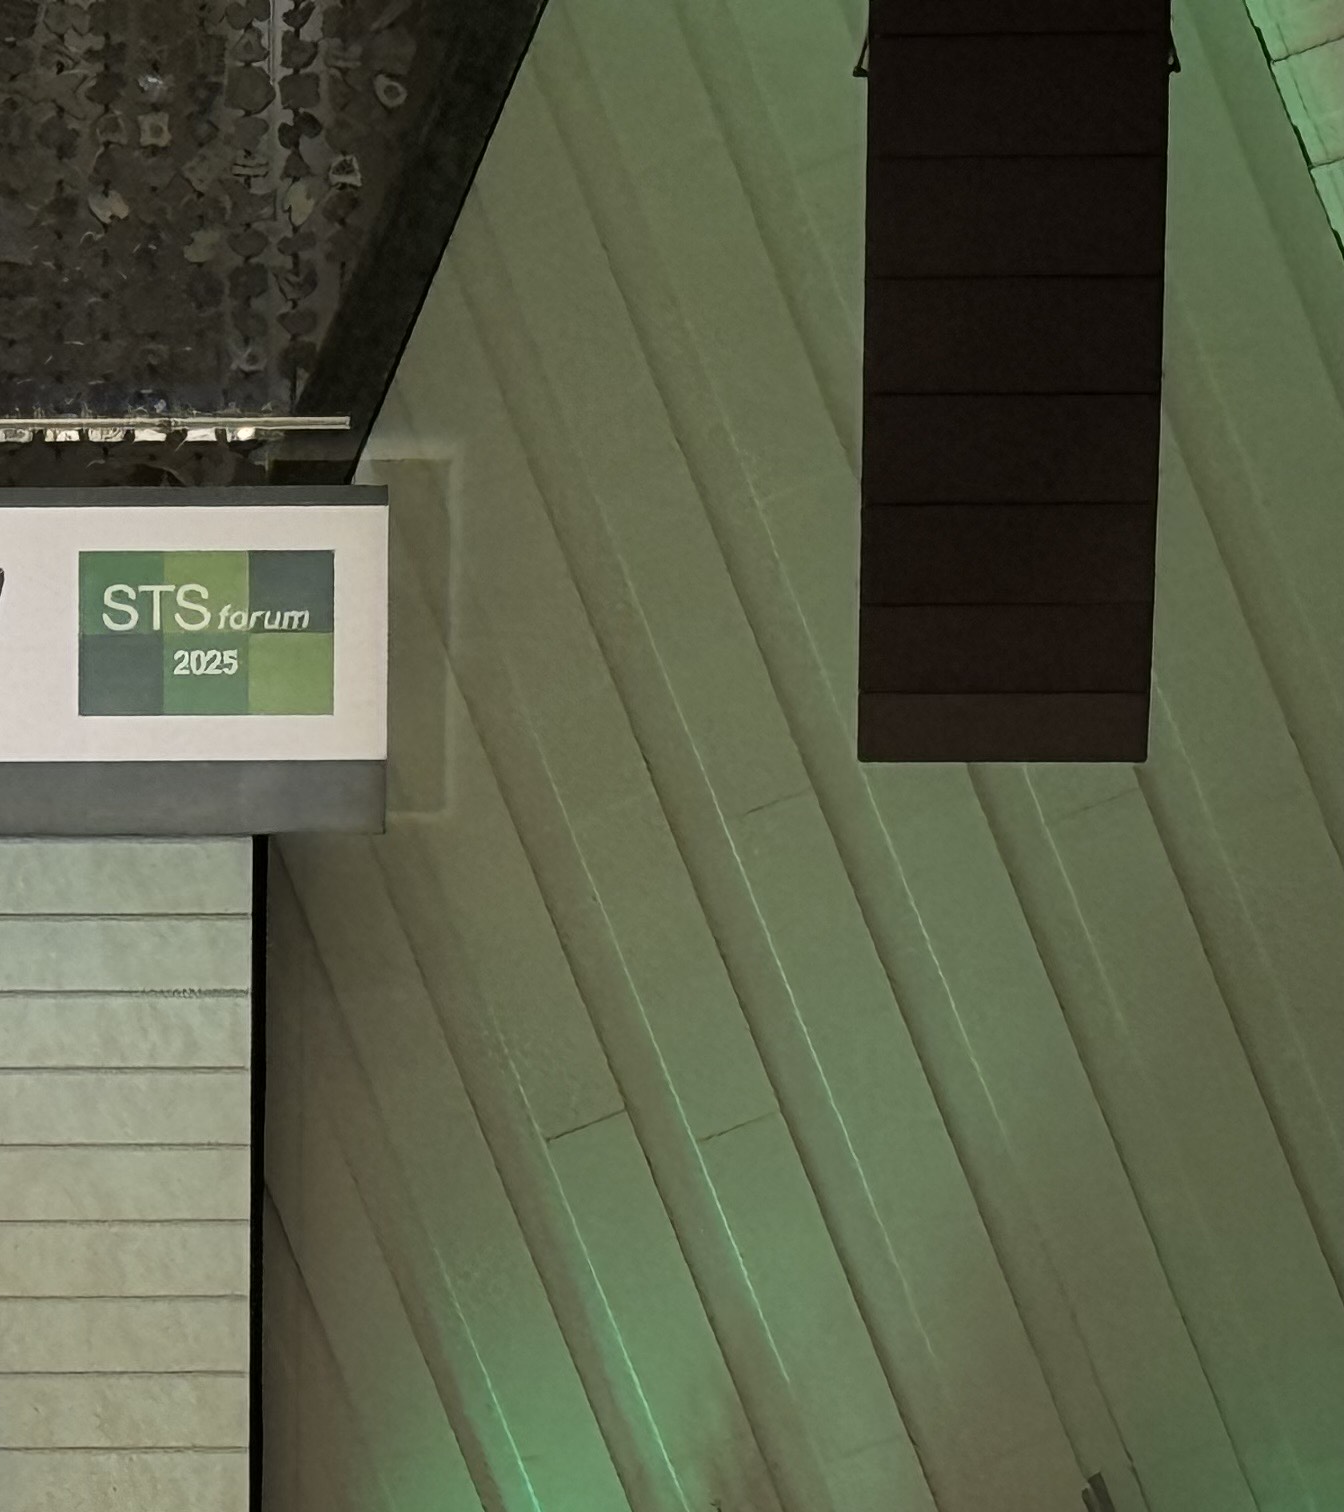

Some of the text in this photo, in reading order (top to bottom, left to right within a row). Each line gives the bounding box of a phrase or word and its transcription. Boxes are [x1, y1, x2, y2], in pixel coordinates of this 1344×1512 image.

[102, 583, 311, 632] STS forum
[173, 649, 239, 676] 2025
